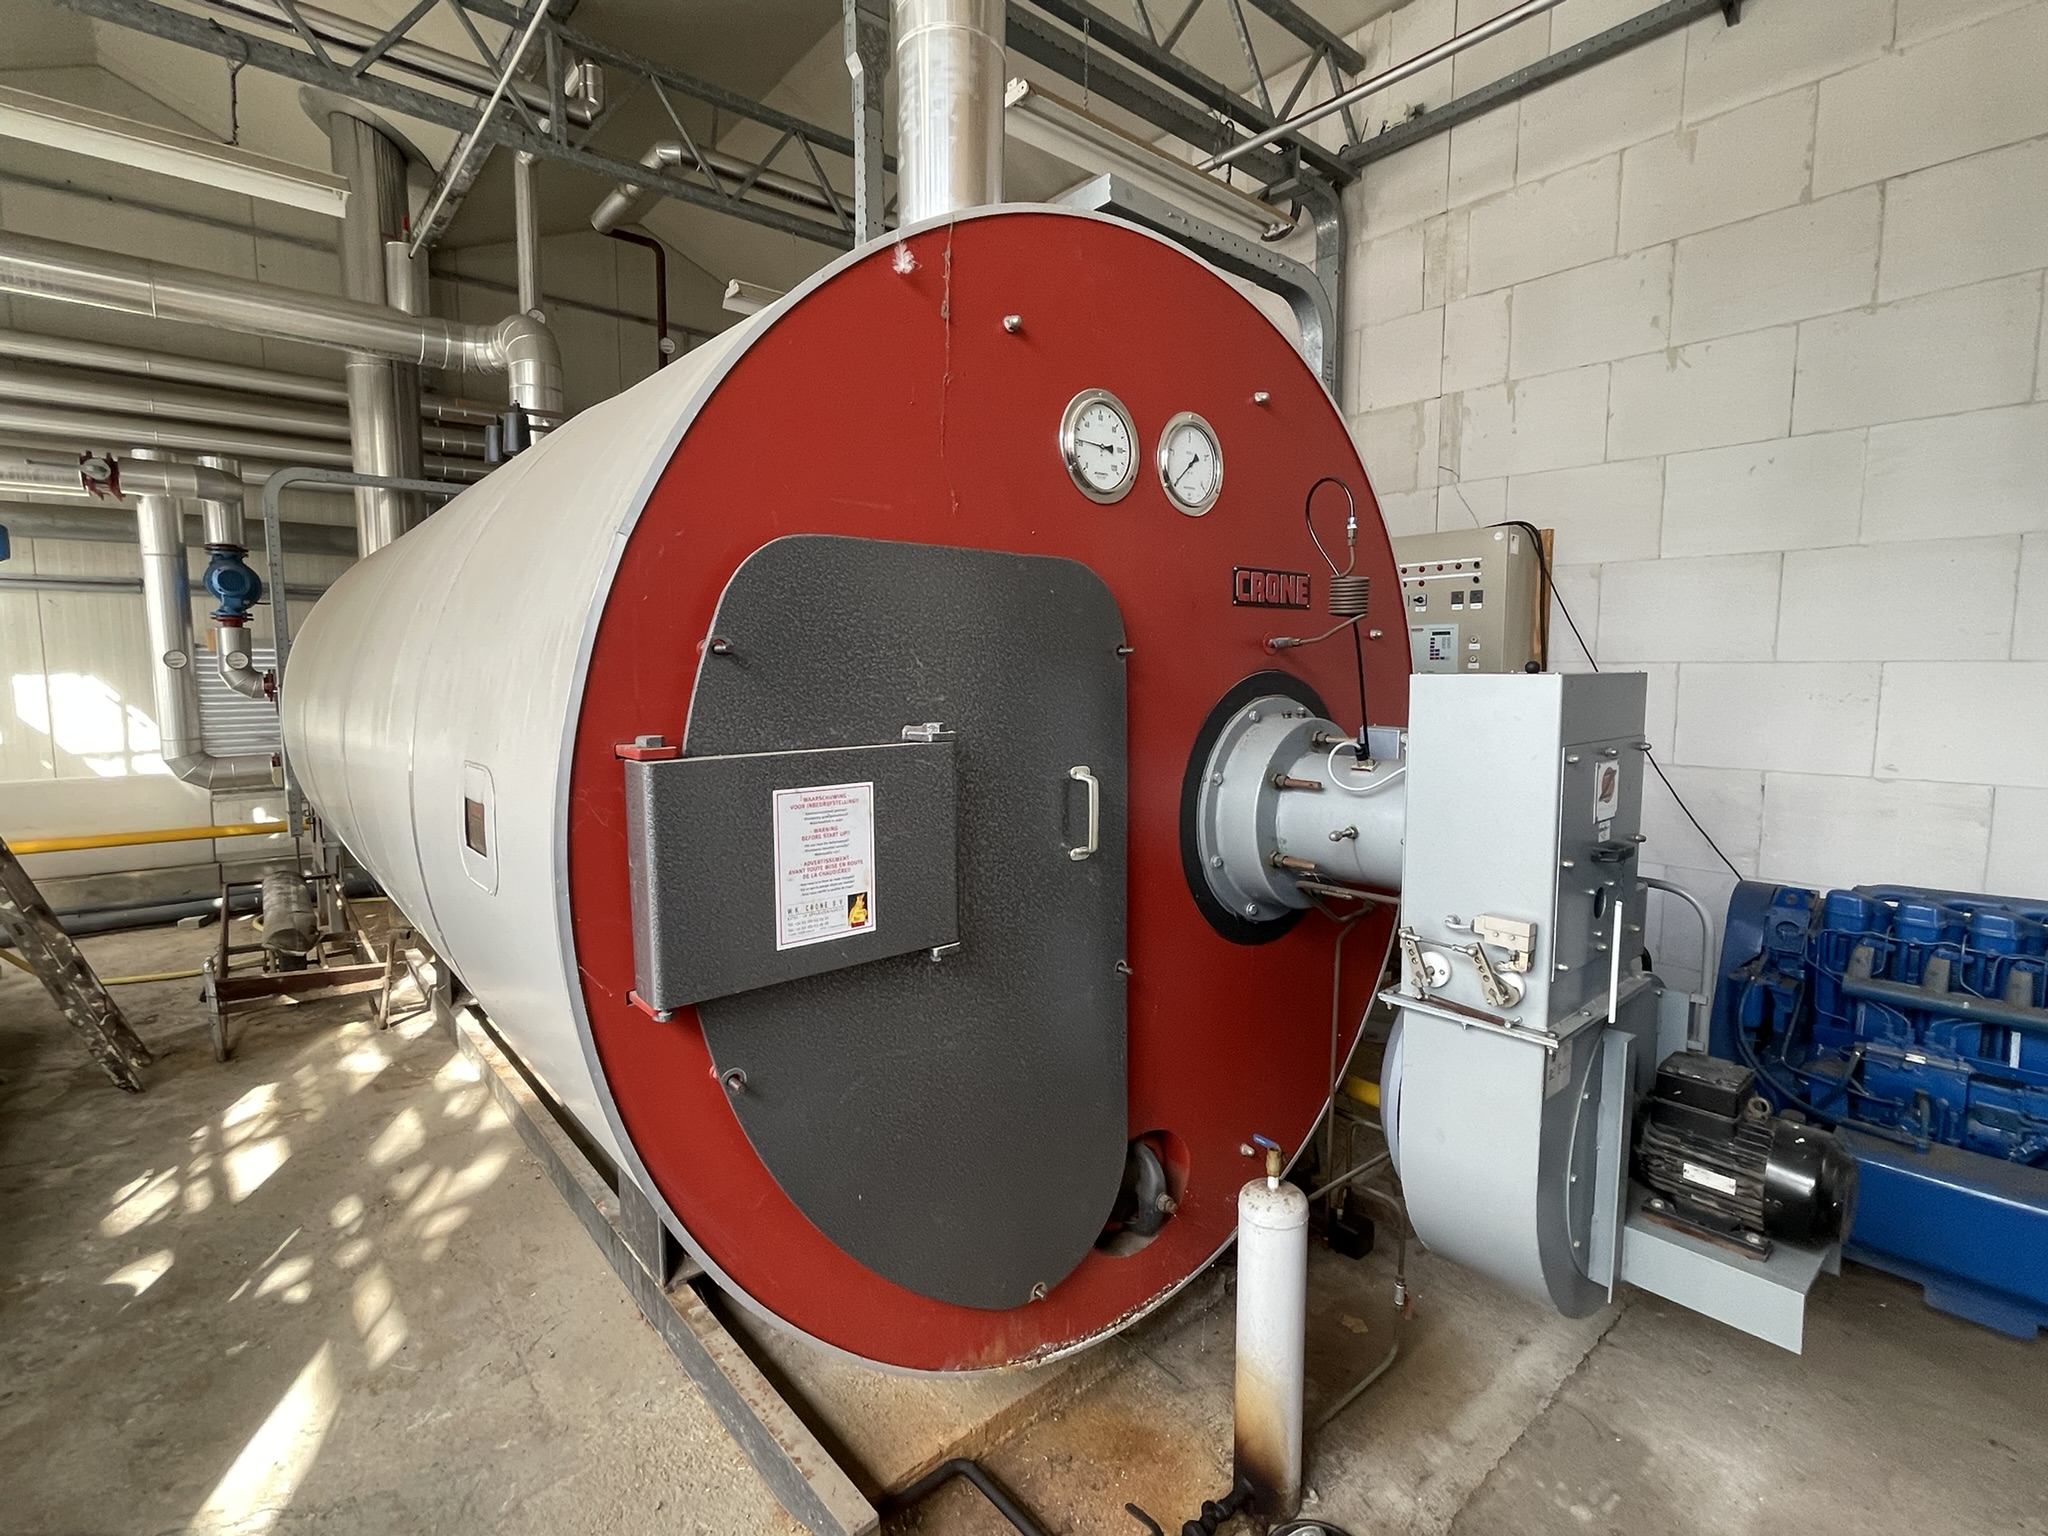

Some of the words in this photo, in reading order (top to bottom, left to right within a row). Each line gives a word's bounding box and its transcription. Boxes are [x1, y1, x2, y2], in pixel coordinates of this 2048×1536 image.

[1236, 570, 1308, 605] CRONE
[813, 825, 839, 833] WARNING
[801, 833, 822, 842] BEFORE
[823, 831, 838, 839] START
[805, 901, 828, 912] CRONE
